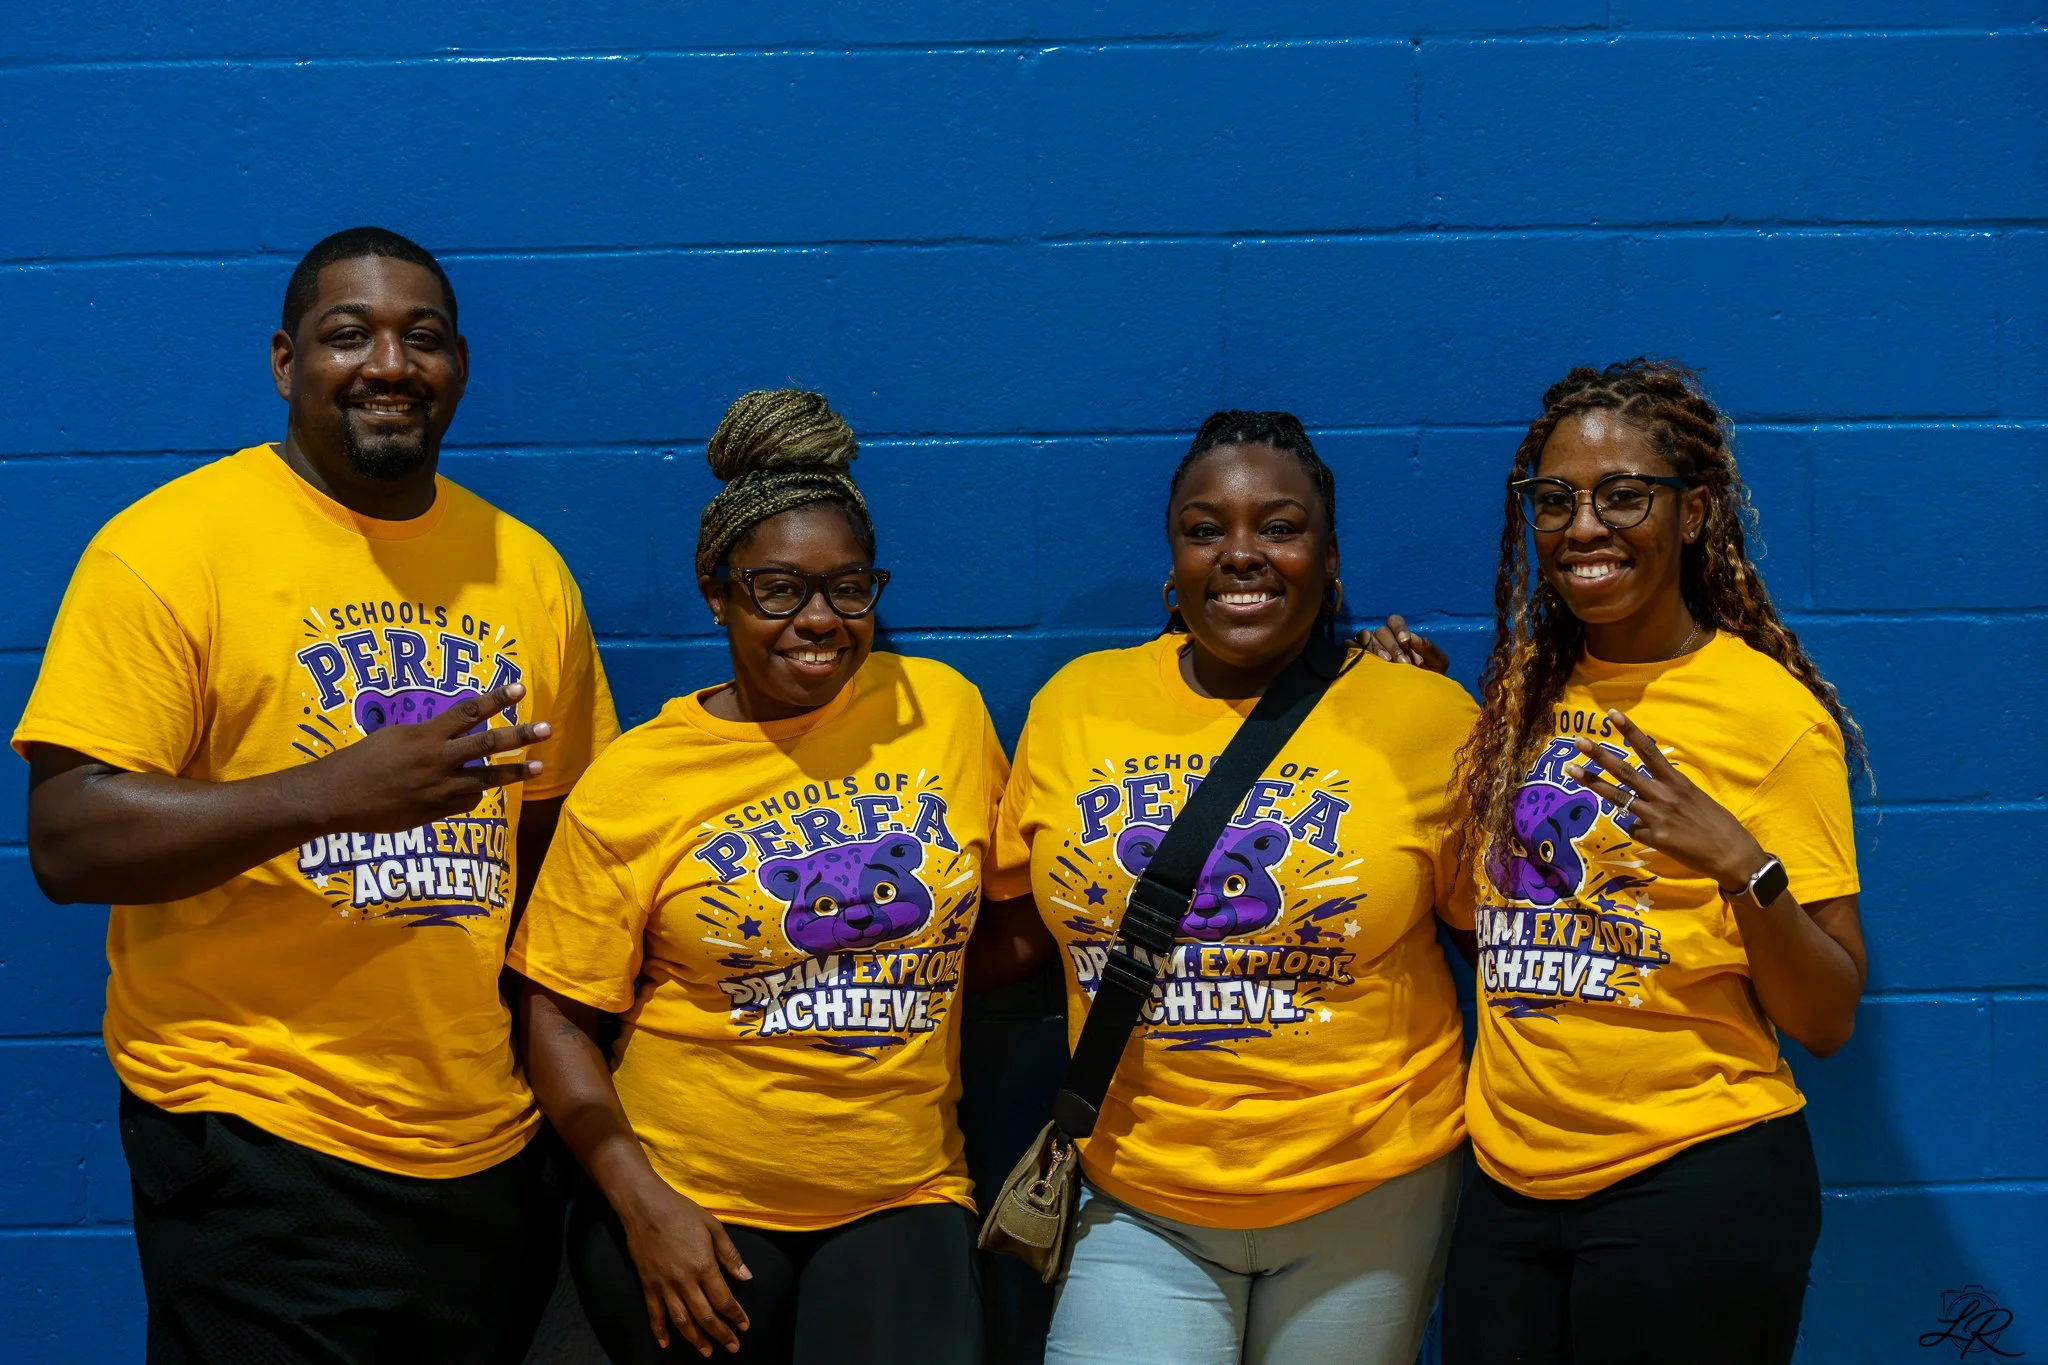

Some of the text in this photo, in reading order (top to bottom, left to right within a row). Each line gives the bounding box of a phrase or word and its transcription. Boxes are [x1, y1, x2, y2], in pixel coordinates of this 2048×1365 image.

[329, 600, 491, 641] SCHOOLS OF
[296, 626, 523, 727] PEREA
[1279, 763, 1320, 781] OF
[724, 772, 909, 829] SCHOOLS OF
[1076, 772, 1352, 855] PEEA
[694, 794, 961, 884] PEREA
[353, 856, 505, 906] ACHIEVE.
[1533, 912, 1669, 963] EXPLORE.
[1200, 947, 1356, 986] EXPLORE.
[760, 987, 934, 1037] ACHIEVE.
[1137, 980, 1306, 1024] CHIEVE.
